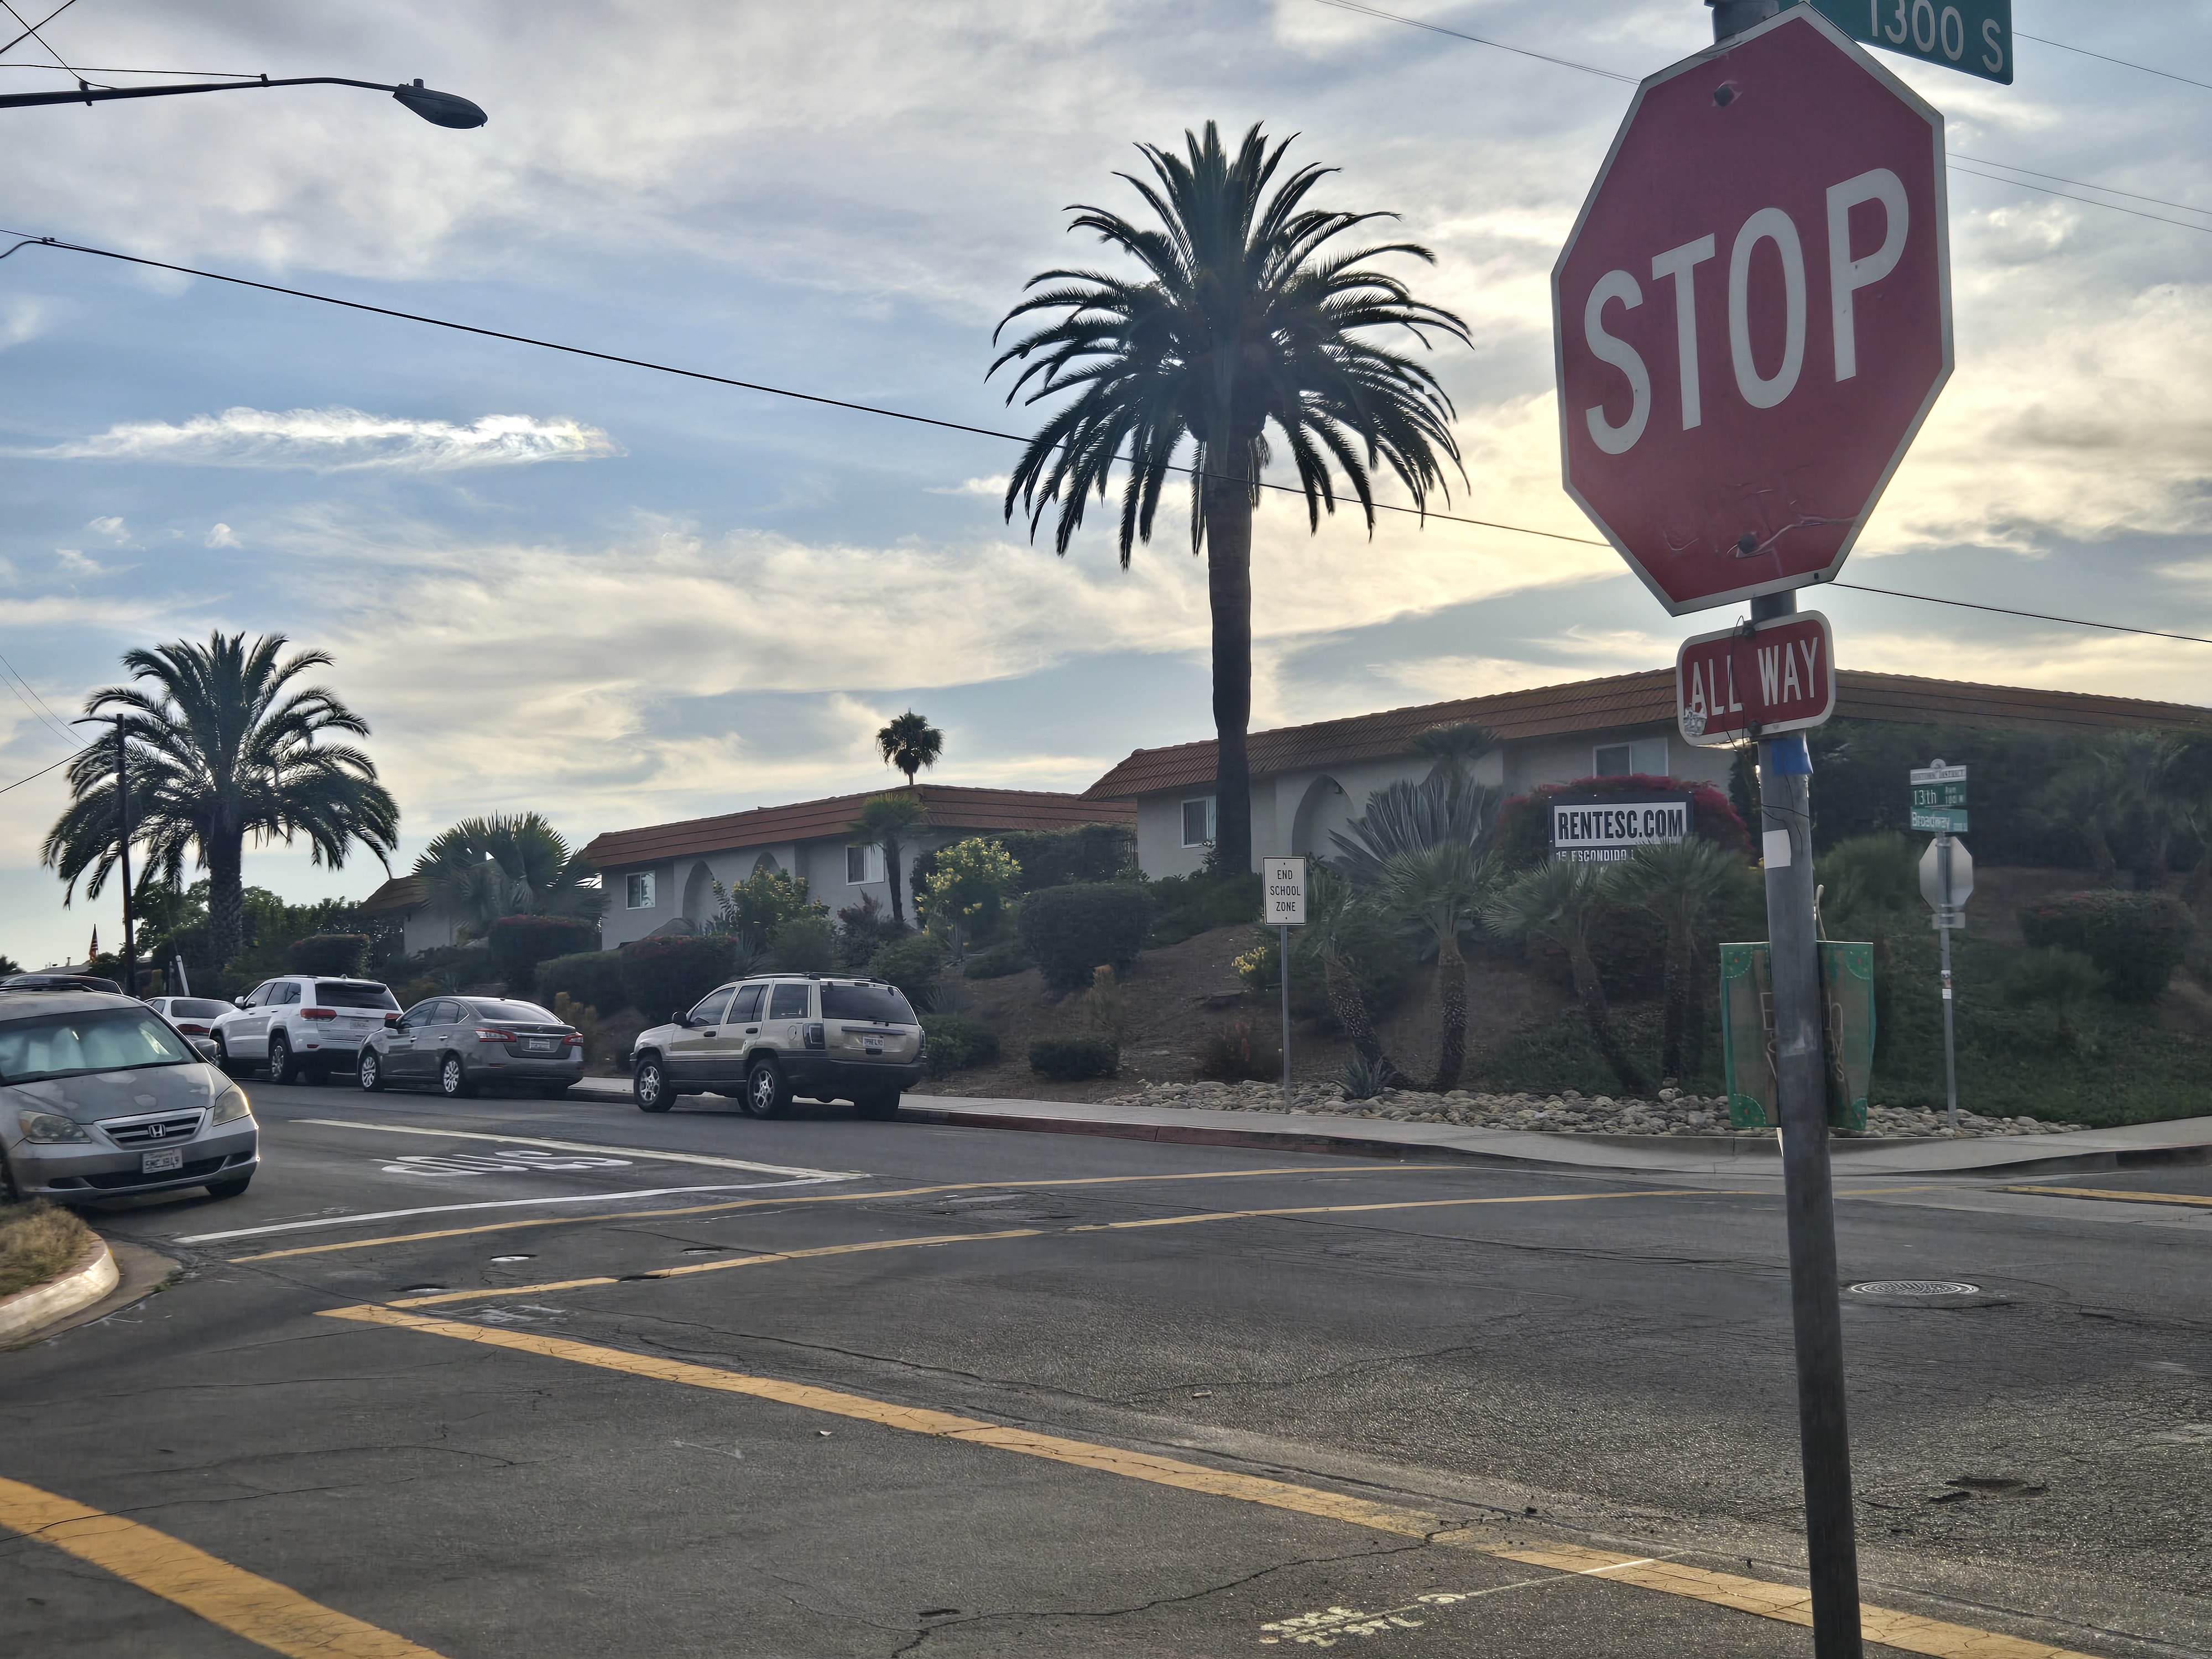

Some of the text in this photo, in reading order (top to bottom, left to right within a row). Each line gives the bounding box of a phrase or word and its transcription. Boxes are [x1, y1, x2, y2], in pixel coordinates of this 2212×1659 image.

[1870, 0, 2003, 73] 1300 S
[1584, 168, 1910, 455] STOP
[1691, 637, 1818, 717] ALL WAY
[1914, 789, 1937, 805] 13th
[1557, 808, 1683, 840] RENTESC.COM
[1277, 869, 1293, 880] END
[1270, 885, 1301, 896] SCHOOL
[1276, 901, 1296, 912] ZONE
